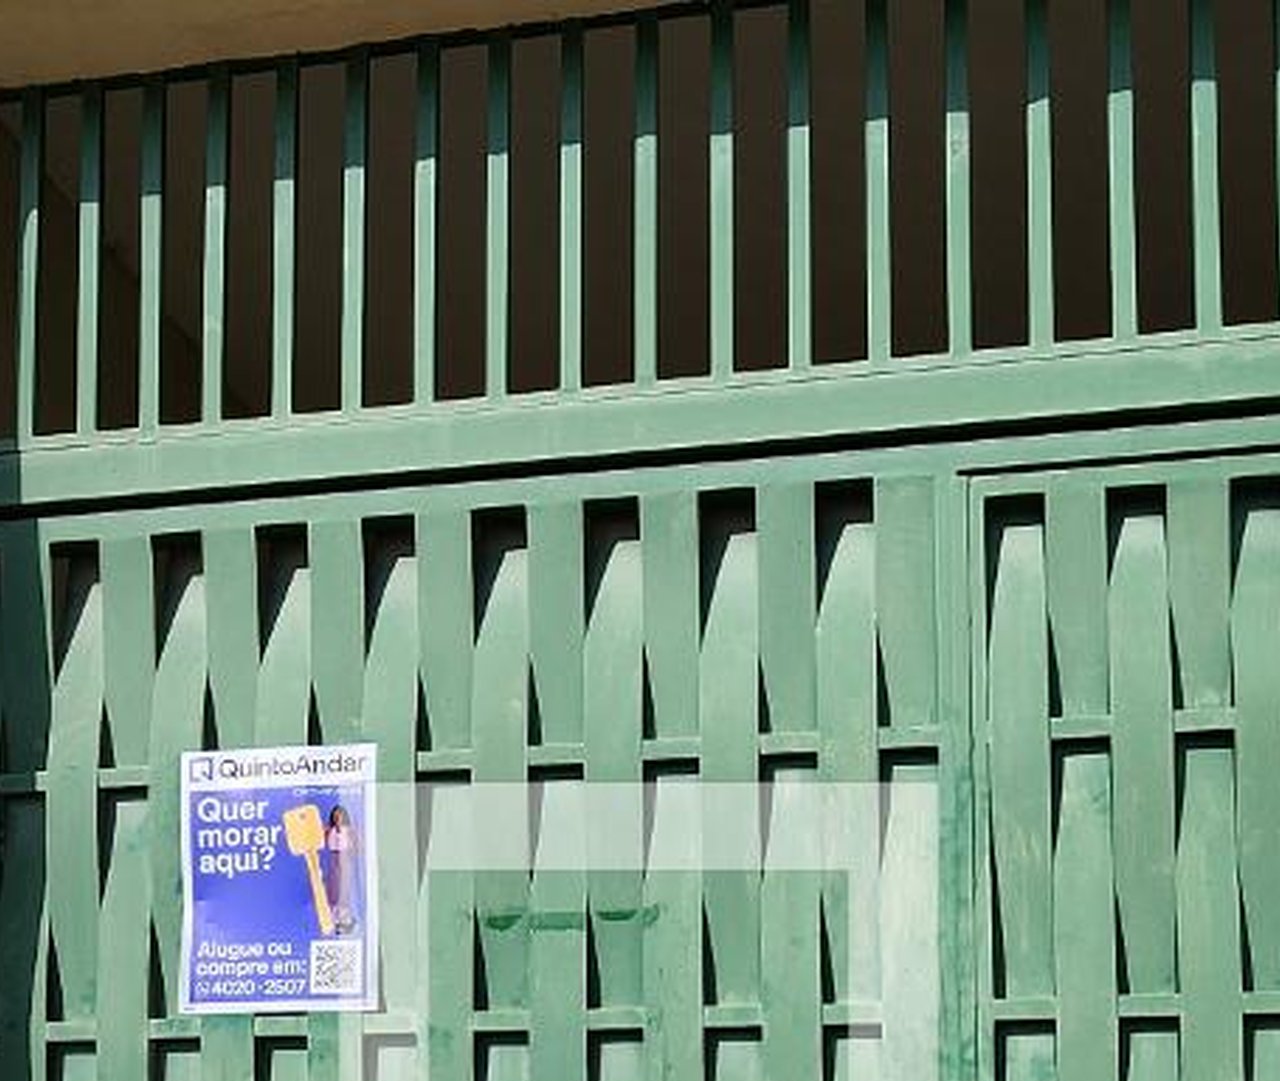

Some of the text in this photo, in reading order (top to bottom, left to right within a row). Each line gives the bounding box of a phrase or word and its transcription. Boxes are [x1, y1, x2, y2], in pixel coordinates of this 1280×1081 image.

[219, 754, 367, 780] QuintoAndar
[197, 798, 269, 824] Quer
[198, 825, 282, 849] morar
[199, 846, 275, 879] aqui?
[197, 941, 293, 961] Alugue ou
[196, 958, 308, 978] compre em:
